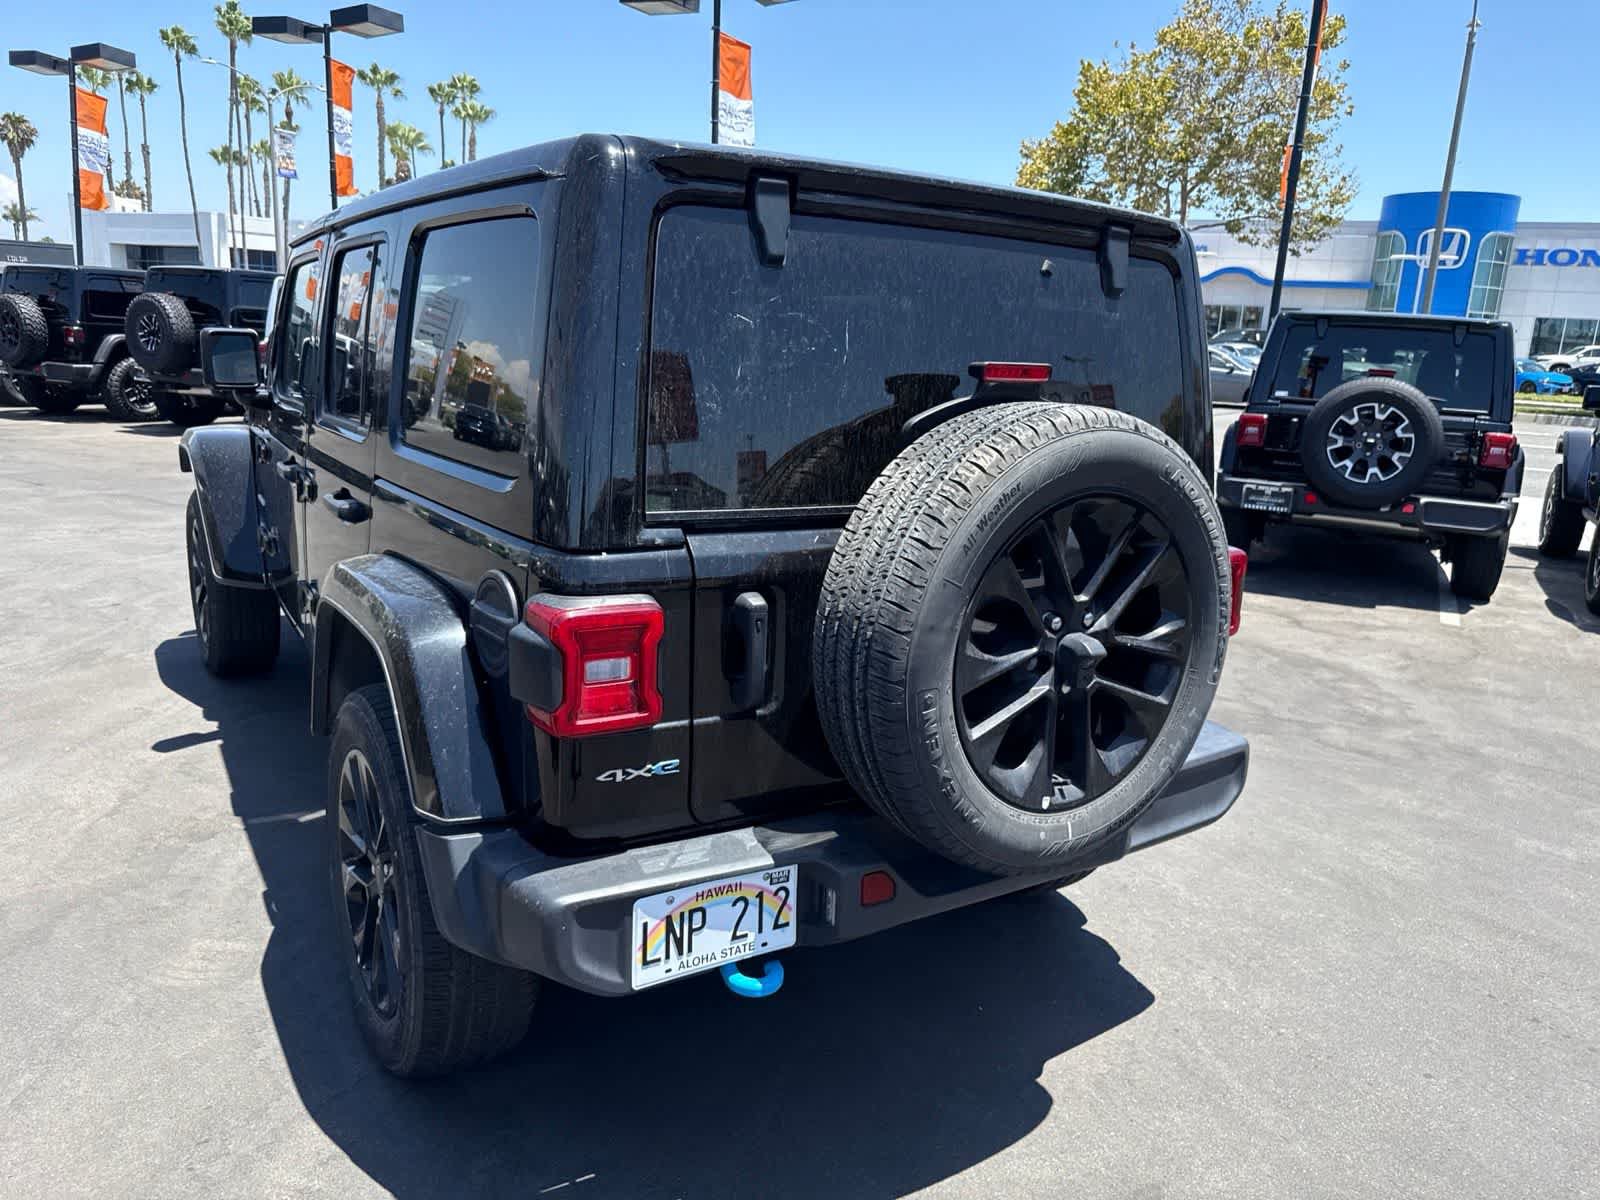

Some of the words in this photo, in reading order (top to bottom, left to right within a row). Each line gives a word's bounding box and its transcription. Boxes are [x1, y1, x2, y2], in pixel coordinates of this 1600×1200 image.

[963, 482, 1022, 556] All-Weather
[695, 881, 743, 902] HAWAII
[641, 906, 707, 966] LNP
[730, 886, 790, 942] 212
[678, 954, 717, 971] ALOHA
[720, 942, 756, 960] STATE
